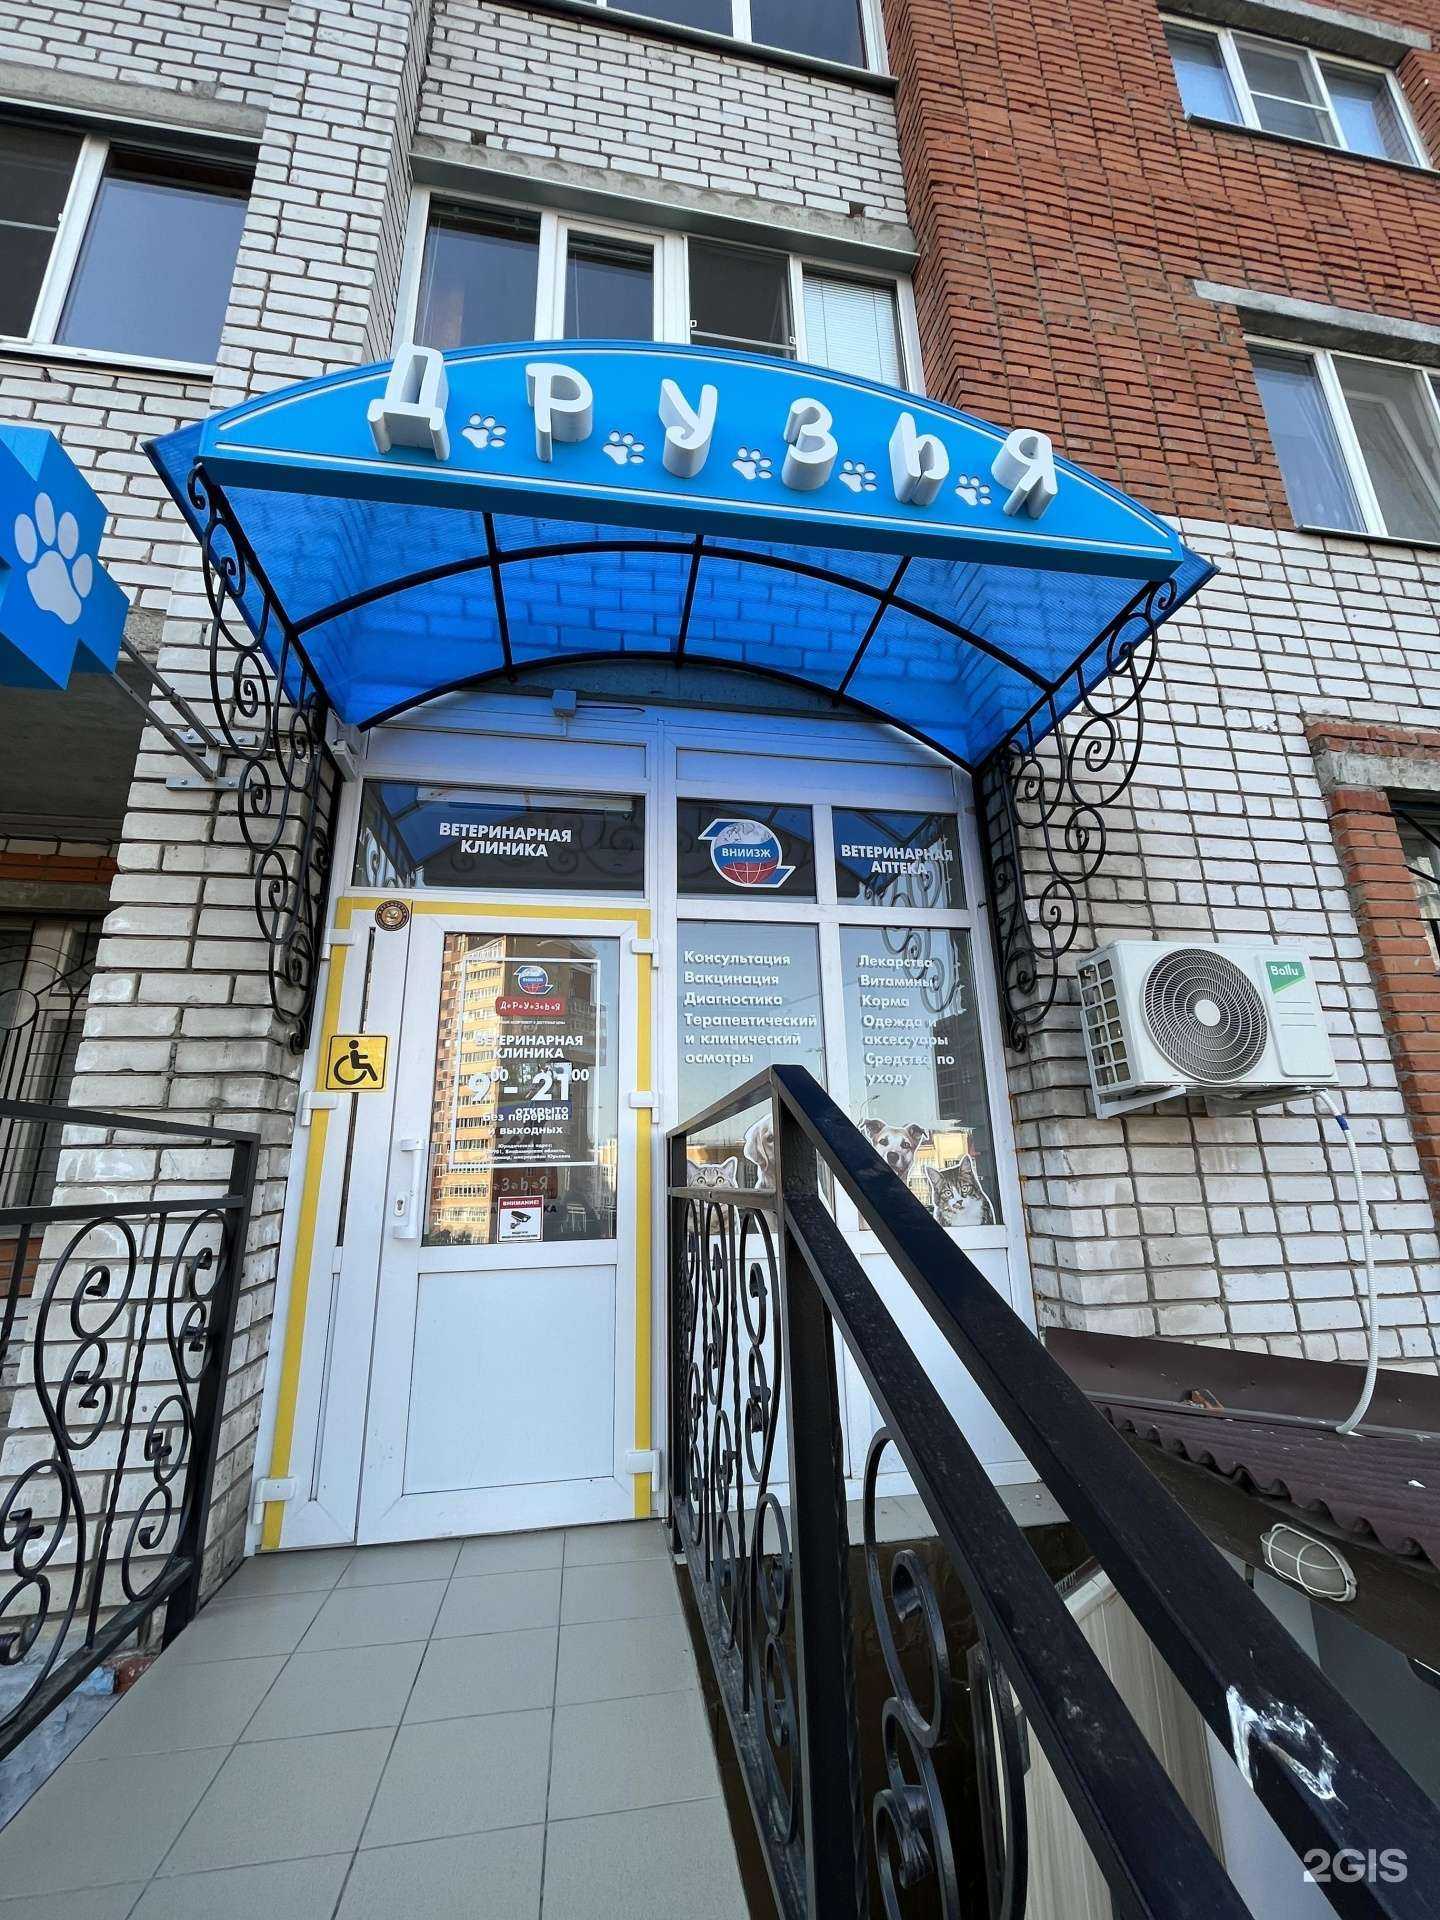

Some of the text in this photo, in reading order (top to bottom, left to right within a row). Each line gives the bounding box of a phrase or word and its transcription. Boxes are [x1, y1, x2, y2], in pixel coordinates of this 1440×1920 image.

[439, 822, 572, 843] ВЕТЕРИНАРНАЯ
[460, 839, 548, 857] КЛИНИКА
[722, 847, 772, 858] ВНИИЗЖ
[841, 844, 953, 862] ВЕТЕРИНАРНАЯ
[871, 860, 928, 875] АПТЕКА
[684, 950, 791, 967] Консультация
[859, 954, 934, 970] Лекарства
[1270, 963, 1299, 976] Ballu
[684, 971, 779, 987] Вакцинация
[860, 974, 939, 988] Витамины
[684, 991, 783, 1006] Диагностика
[861, 994, 910, 1009] Корма
[684, 1013, 817, 1029] Терапевтический
[863, 1014, 923, 1028] Одежда
[685, 1033, 801, 1046] и клинический
[864, 1034, 949, 1048] аксессуары
[494, 1047, 565, 1060] КЛИНИКА
[685, 1053, 754, 1067] осмотры
[937, 1055, 955, 1065] по
[866, 1073, 912, 1086] уходу
[500, 1126, 564, 1136] выходных
